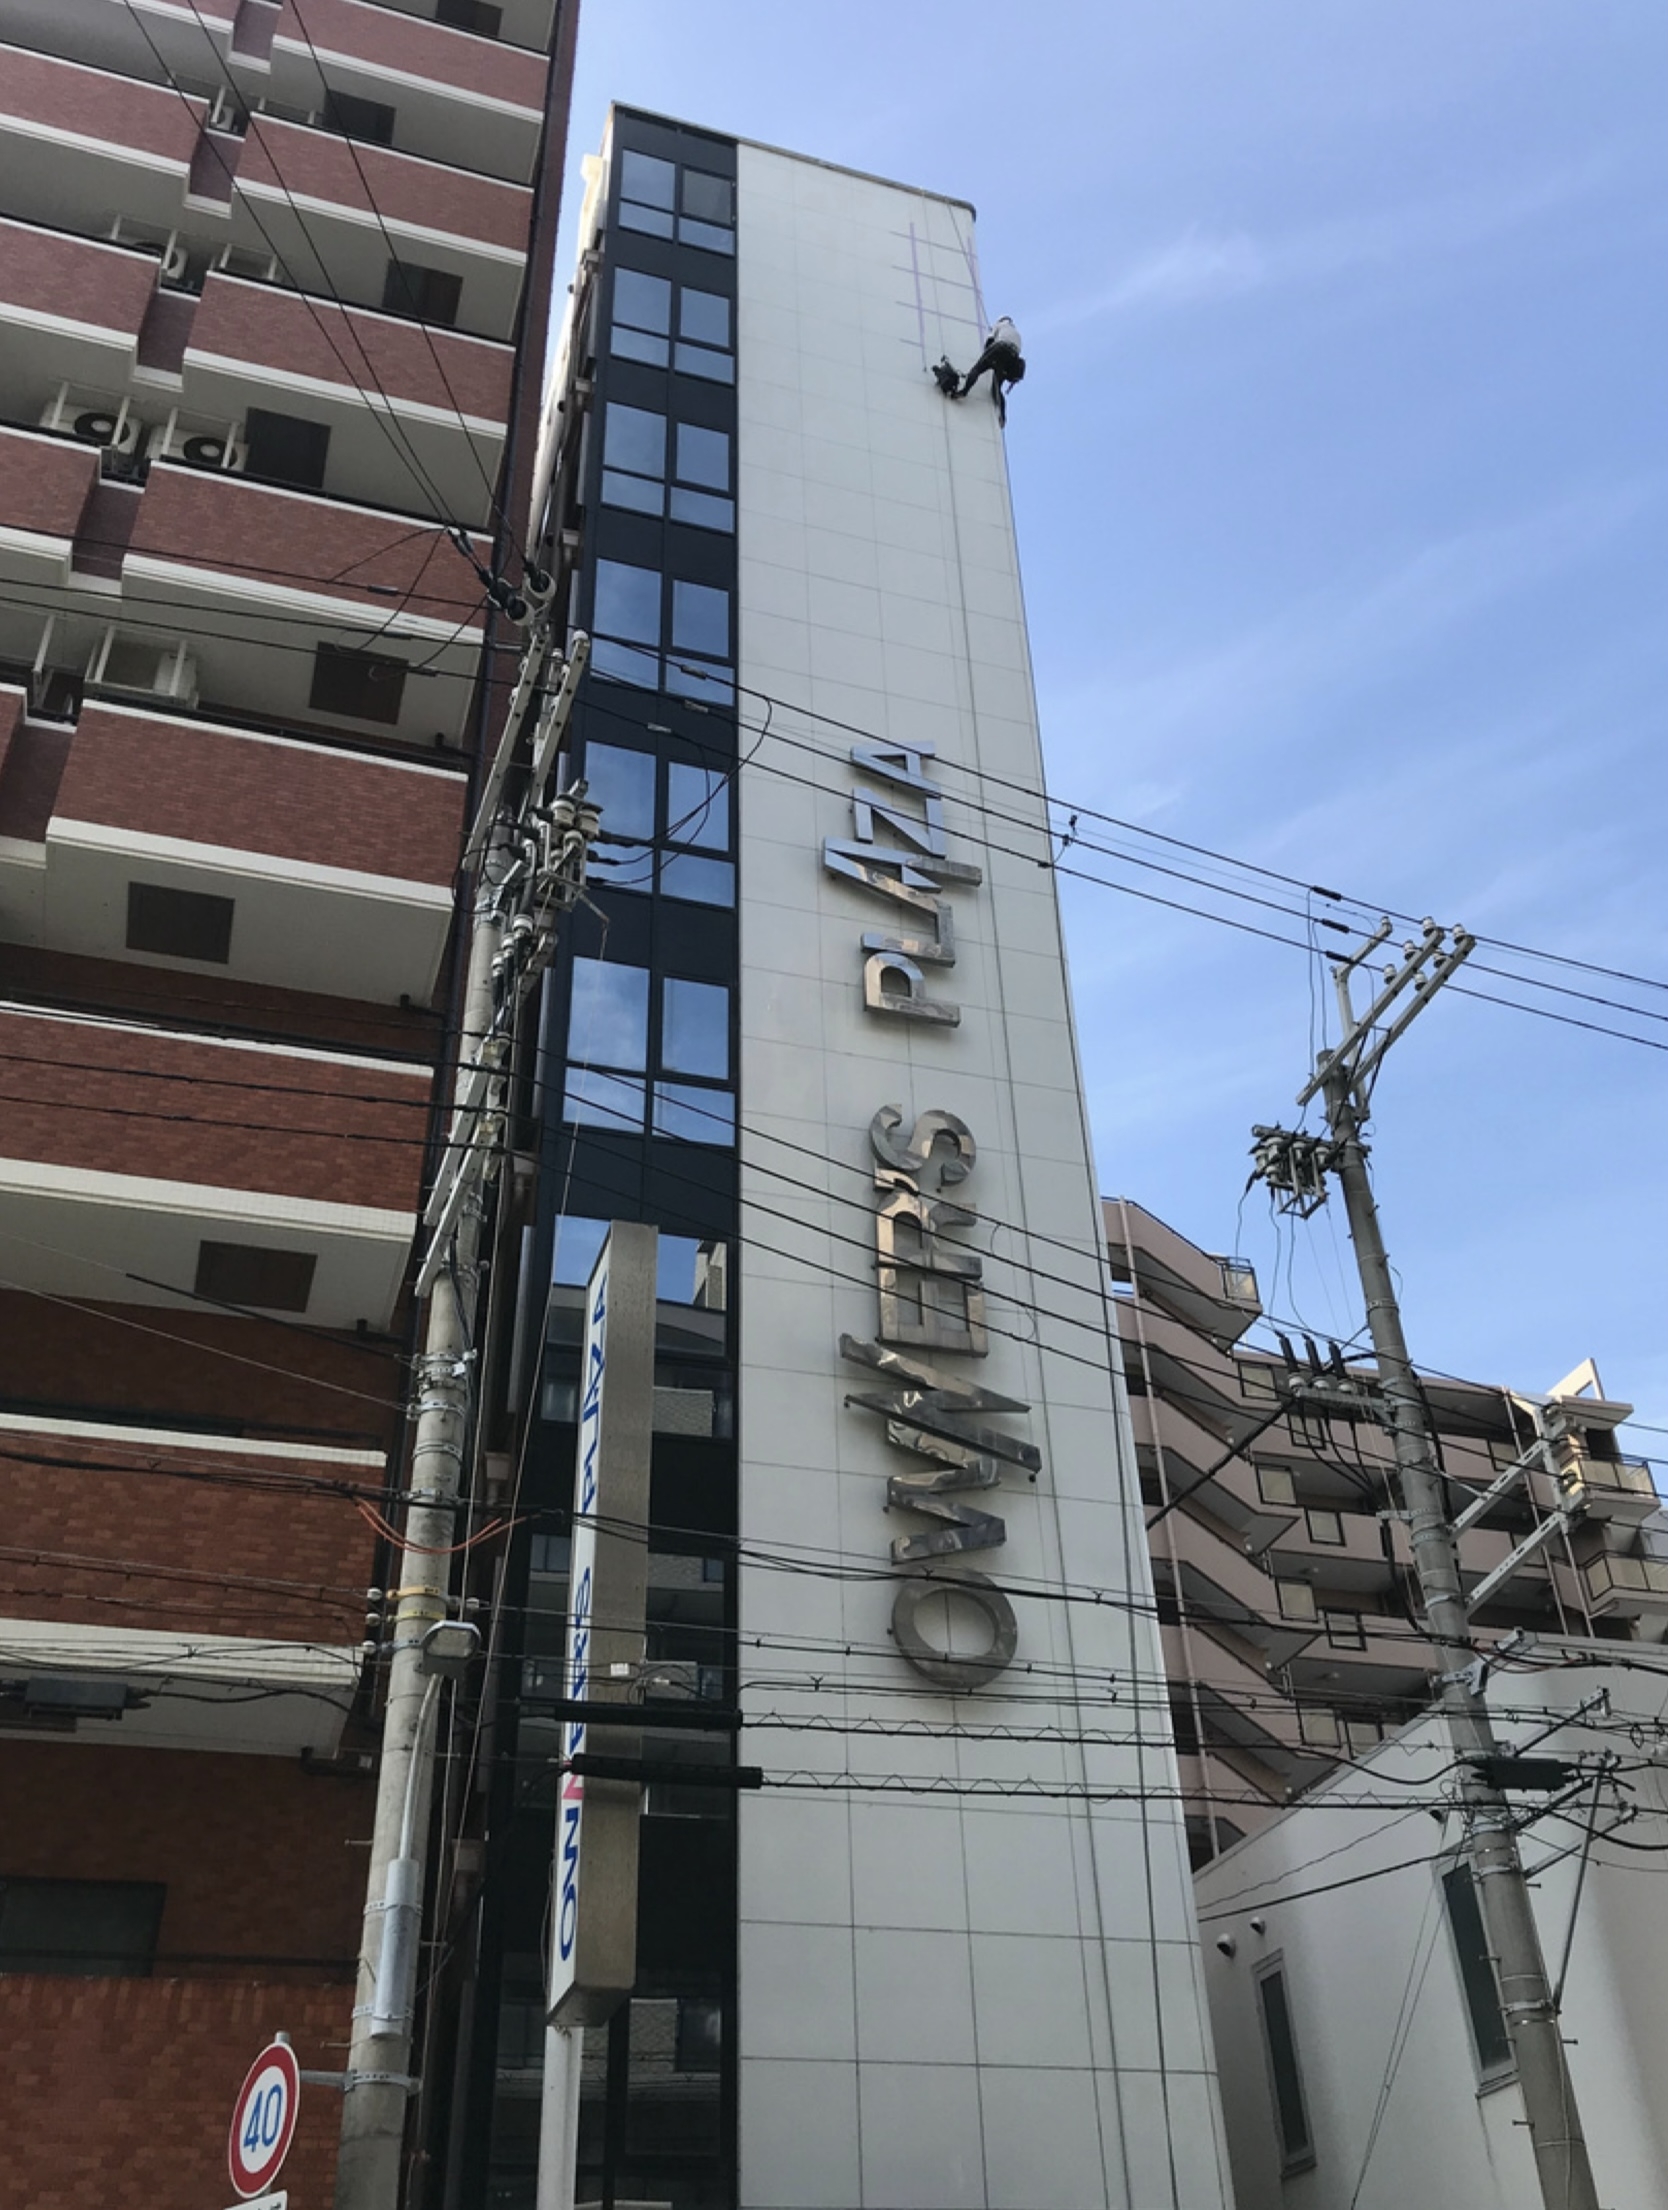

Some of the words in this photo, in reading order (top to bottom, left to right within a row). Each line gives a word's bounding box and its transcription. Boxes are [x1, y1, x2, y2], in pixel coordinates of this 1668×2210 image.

[823, 740, 983, 1028] PLAZA
[583, 1272, 607, 1515] PLAZA
[839, 1103, 1042, 1690] OWNER'S
[243, 2083, 283, 2153] 40
